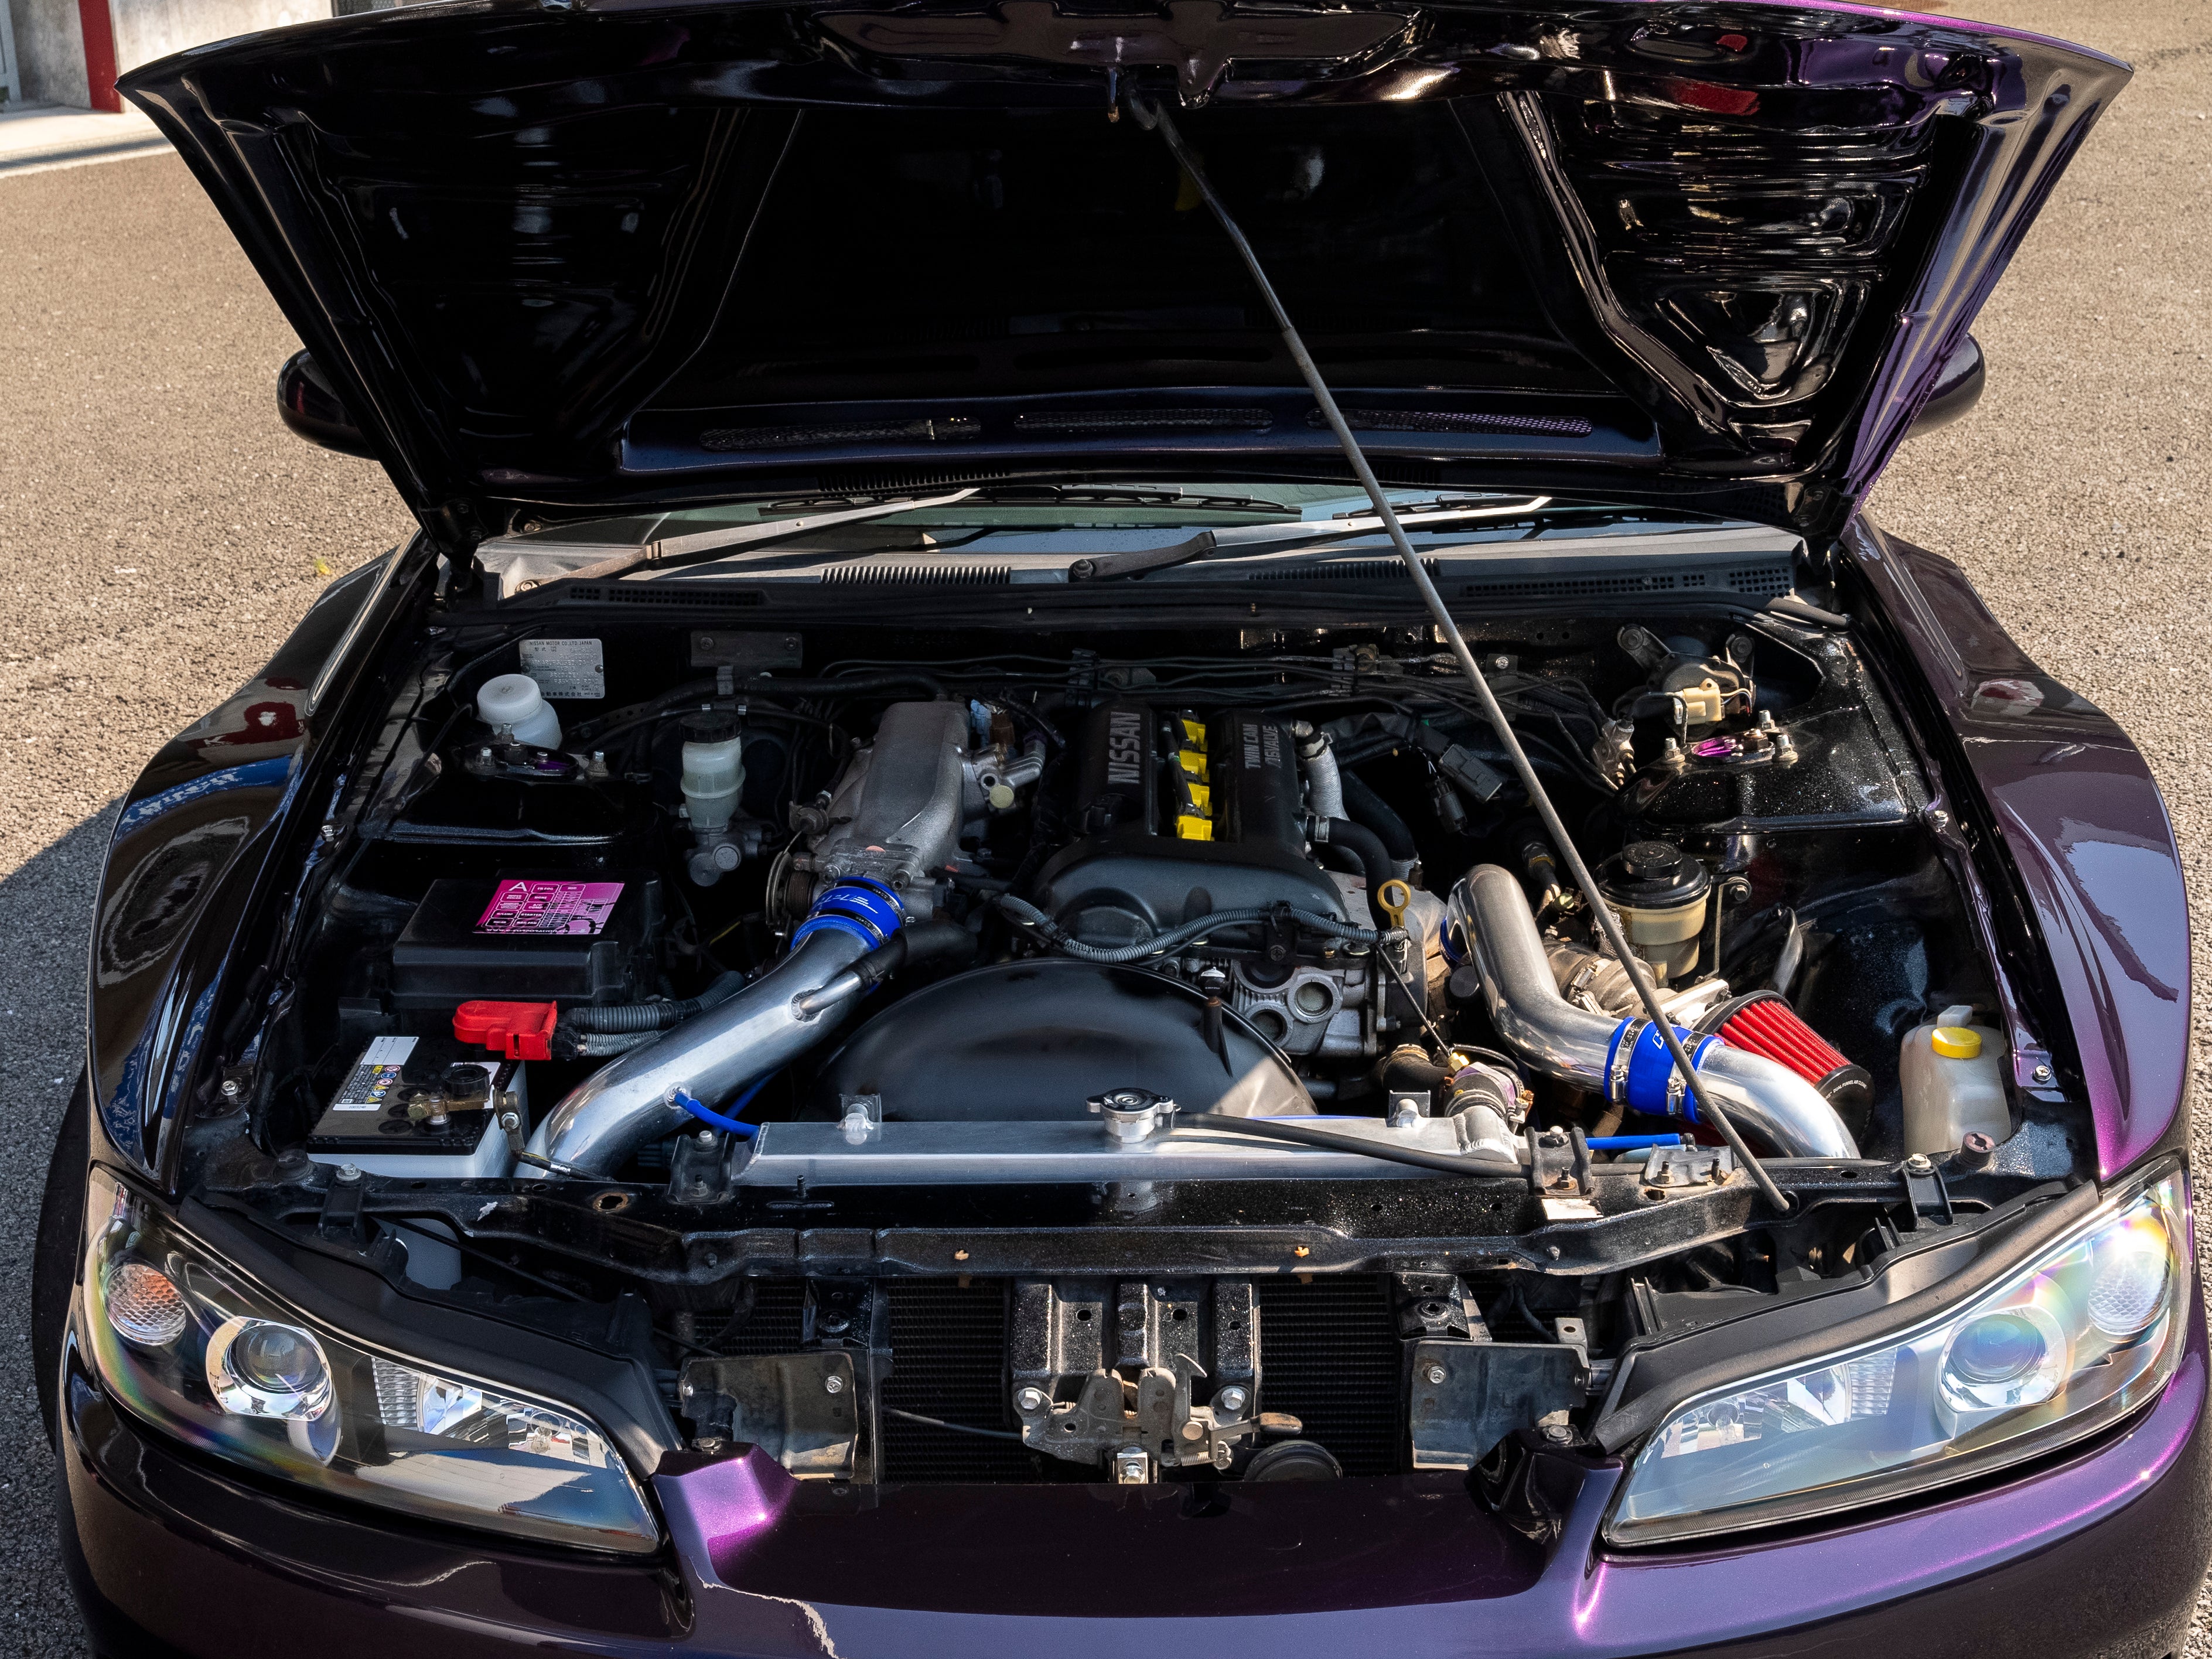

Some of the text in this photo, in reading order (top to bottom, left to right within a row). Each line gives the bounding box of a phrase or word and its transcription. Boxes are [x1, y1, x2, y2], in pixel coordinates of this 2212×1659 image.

[1108, 712, 1141, 784] NISSAN
[1242, 724, 1261, 769] TWIN CAM
[508, 882, 528, 892] A
